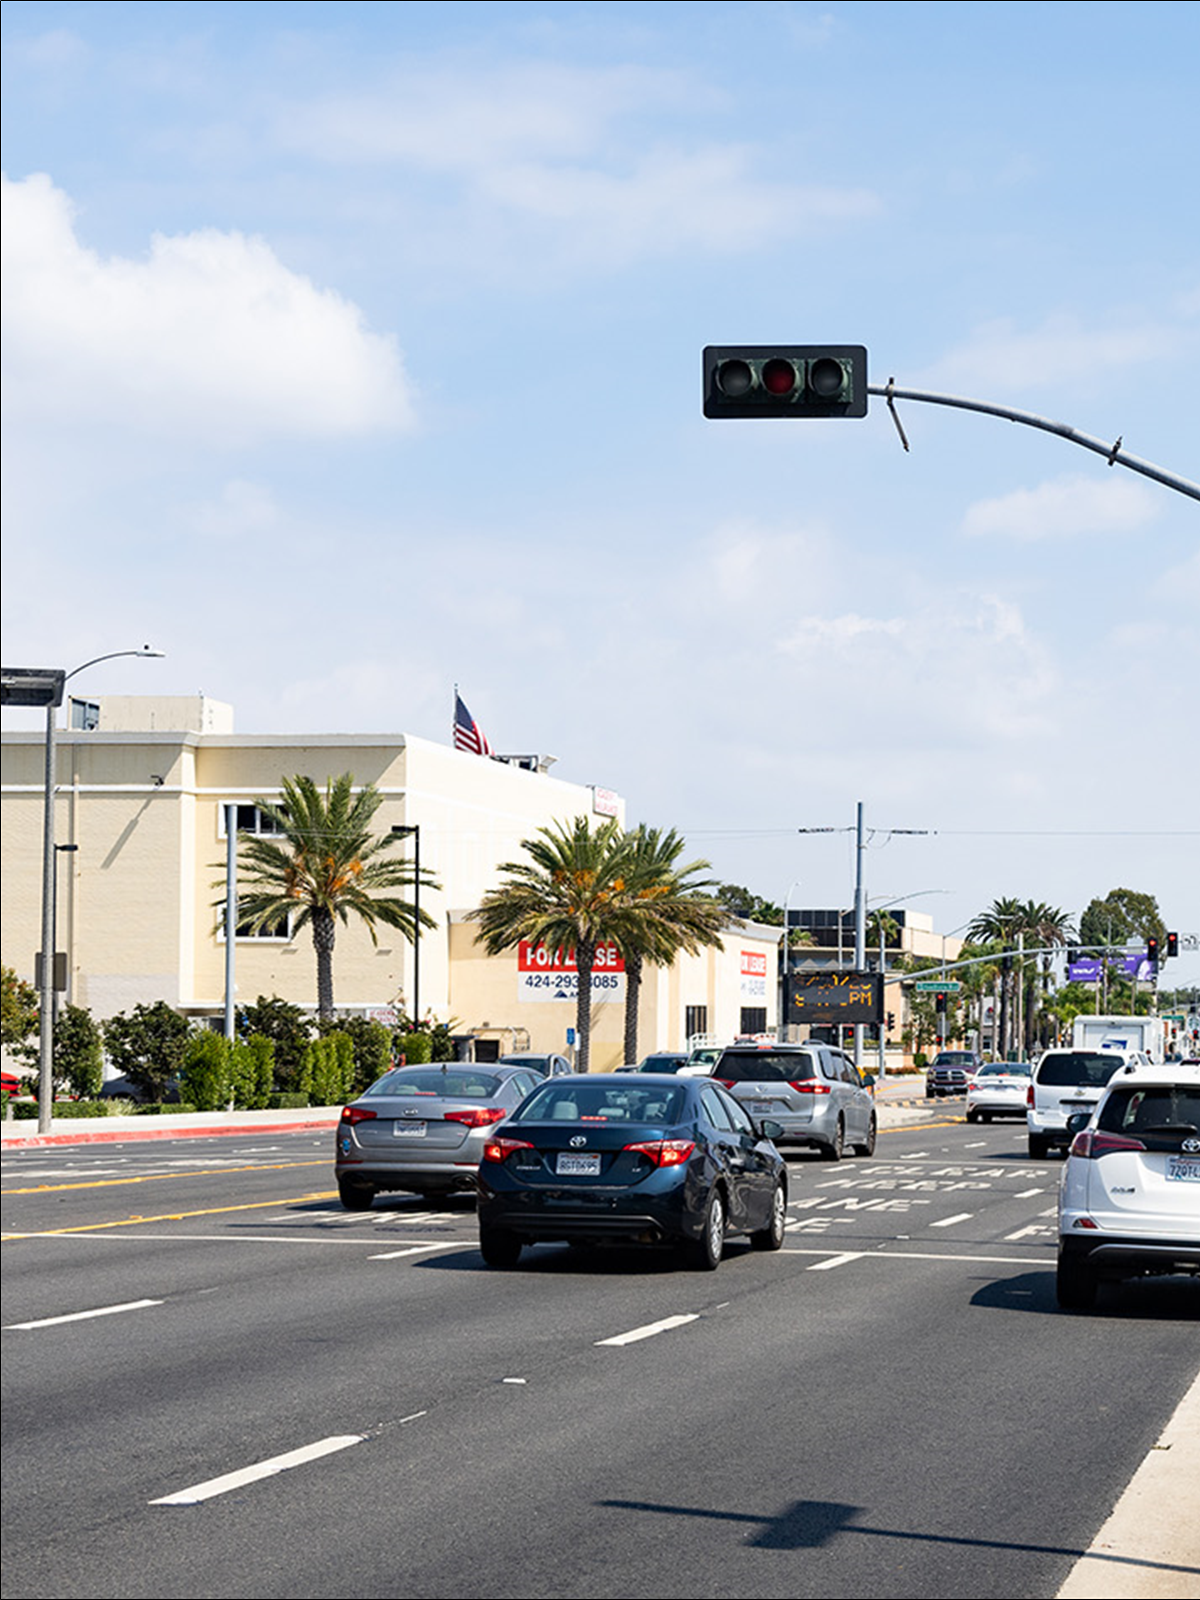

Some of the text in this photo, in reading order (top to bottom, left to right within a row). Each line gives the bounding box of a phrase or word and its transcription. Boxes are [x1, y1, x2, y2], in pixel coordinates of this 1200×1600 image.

[526, 947, 617, 966] FOR LSE
[525, 975, 618, 988] 424-293085
